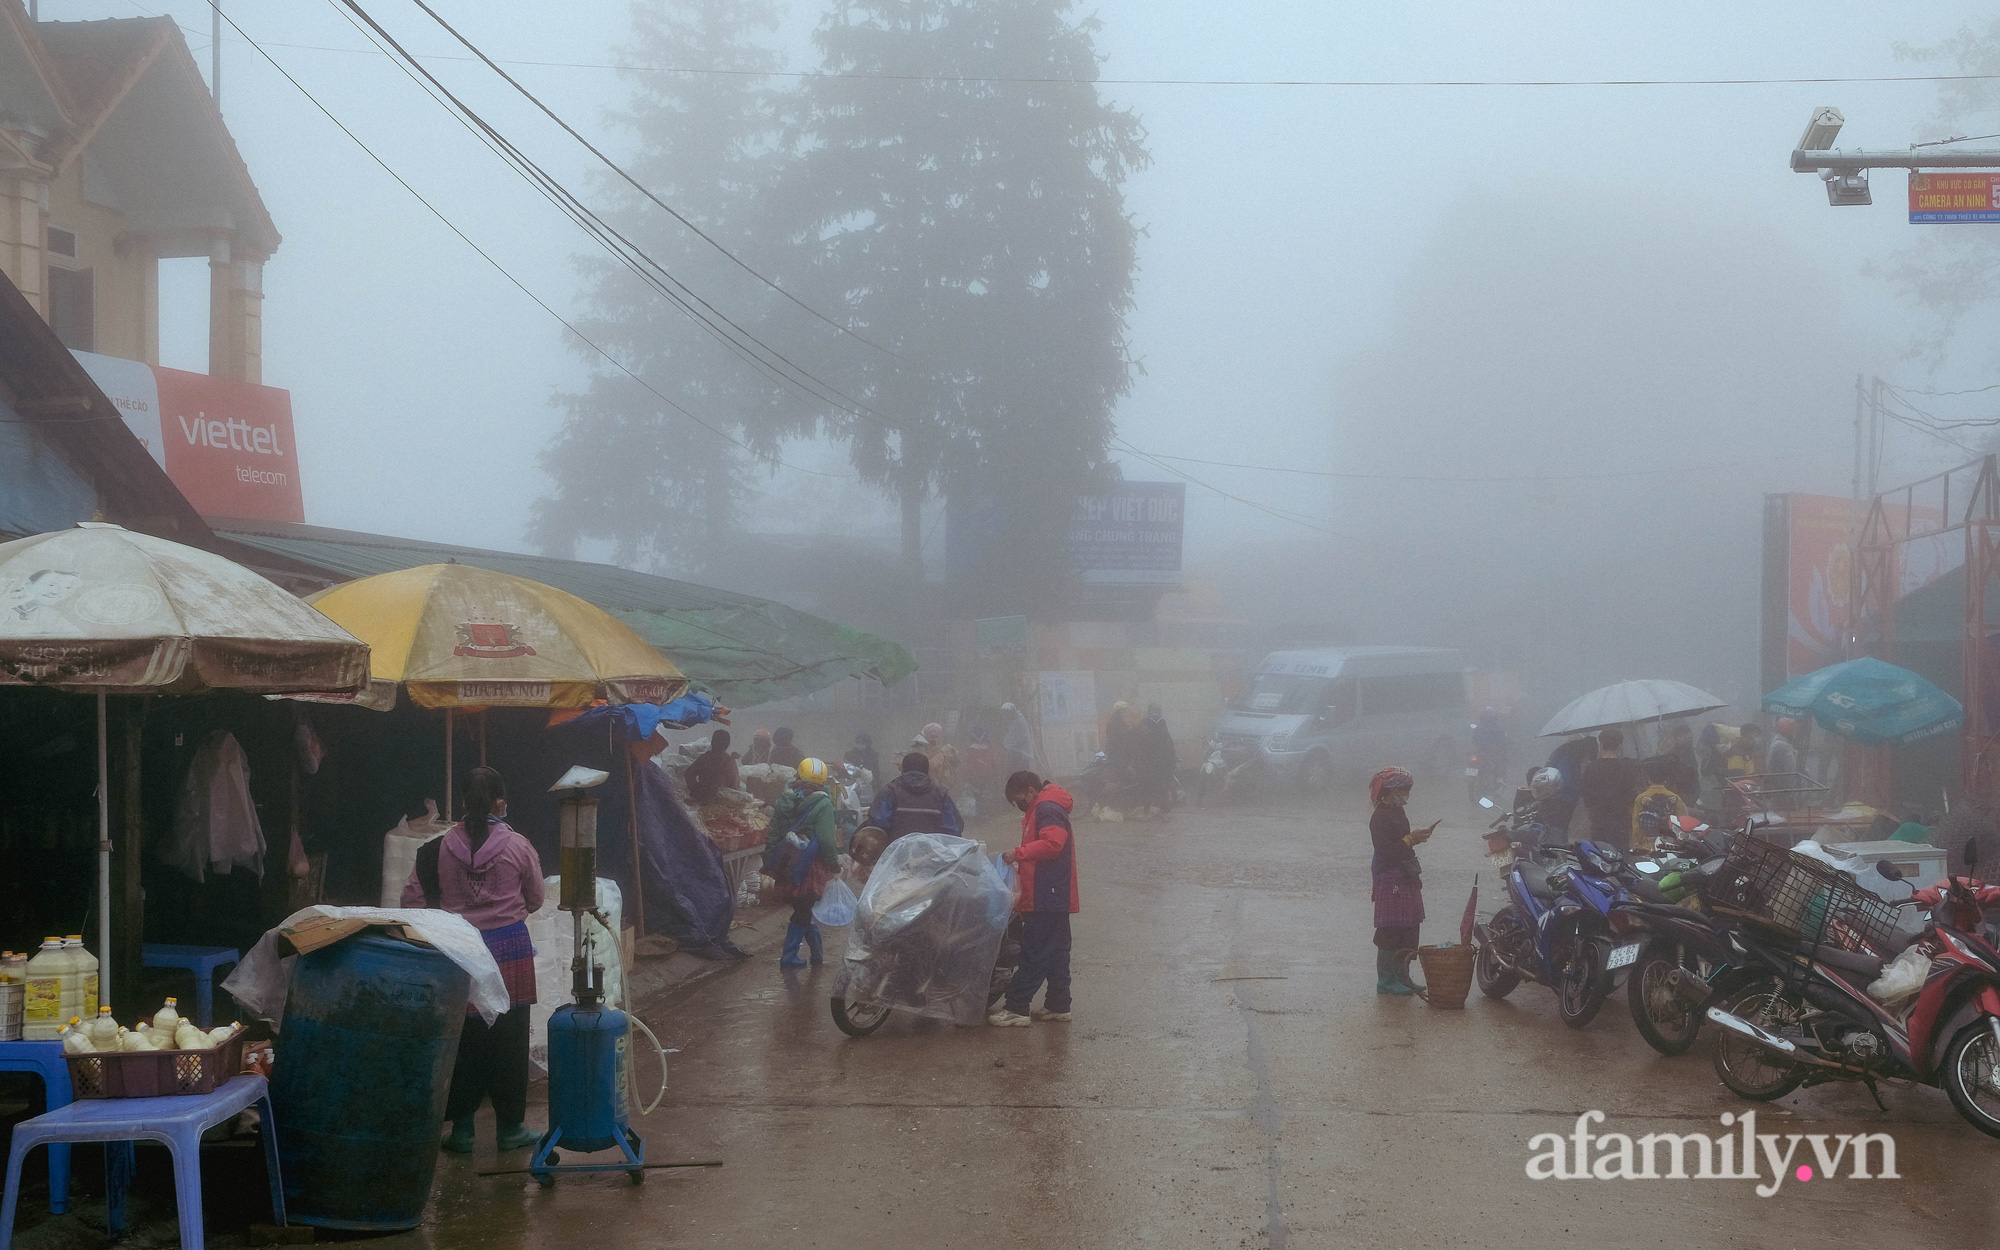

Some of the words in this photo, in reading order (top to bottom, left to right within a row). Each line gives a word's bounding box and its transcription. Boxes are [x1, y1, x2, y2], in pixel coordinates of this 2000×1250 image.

[1919, 195, 1950, 208] CAMERA
[1953, 195, 1965, 208] AN
[1967, 194, 1986, 208] NINH
[178, 411, 284, 456] viettel
[235, 464, 287, 486] telecom
